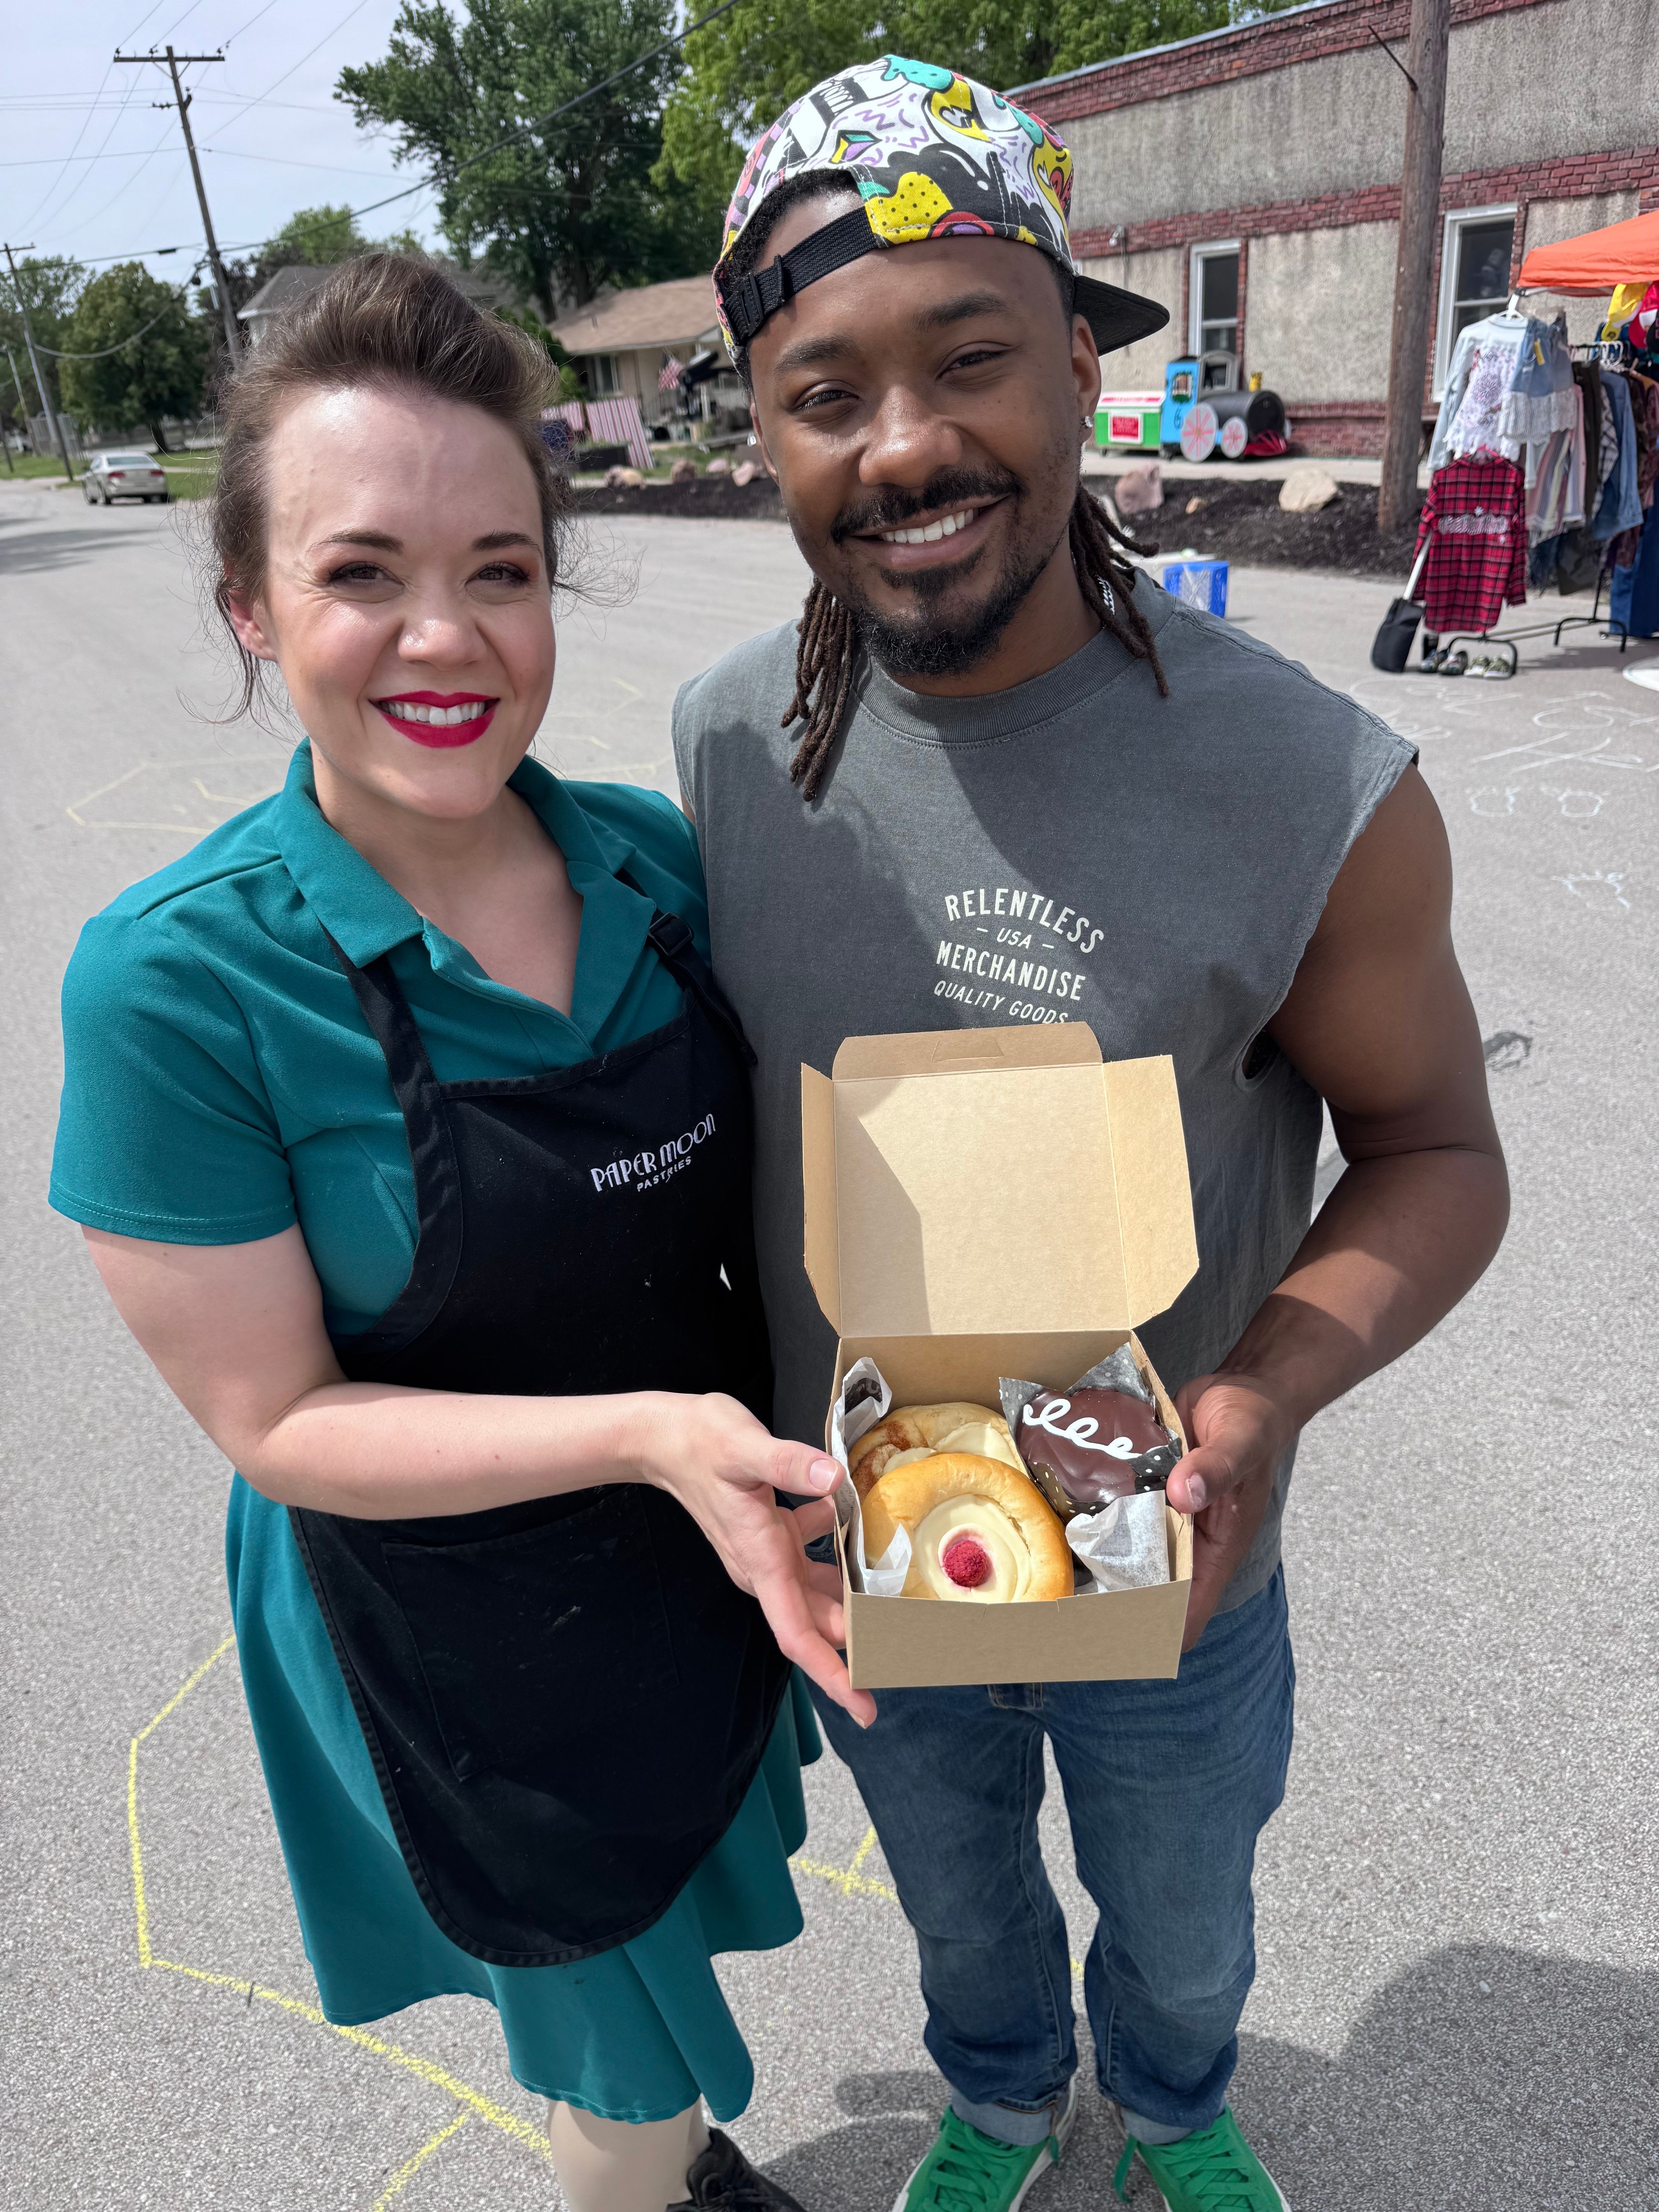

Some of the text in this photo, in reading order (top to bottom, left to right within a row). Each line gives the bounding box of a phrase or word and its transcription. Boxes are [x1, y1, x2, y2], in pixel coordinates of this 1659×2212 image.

[945, 888, 1104, 953] RELENTLESS
[996, 927, 1031, 949] USA
[936, 940, 1086, 1001] MERCHANDISE
[934, 980, 1068, 1024] QUALITY GOODS
[590, 1113, 716, 1192] PAPER MOON
[636, 1156, 692, 1192] PASTRIES
